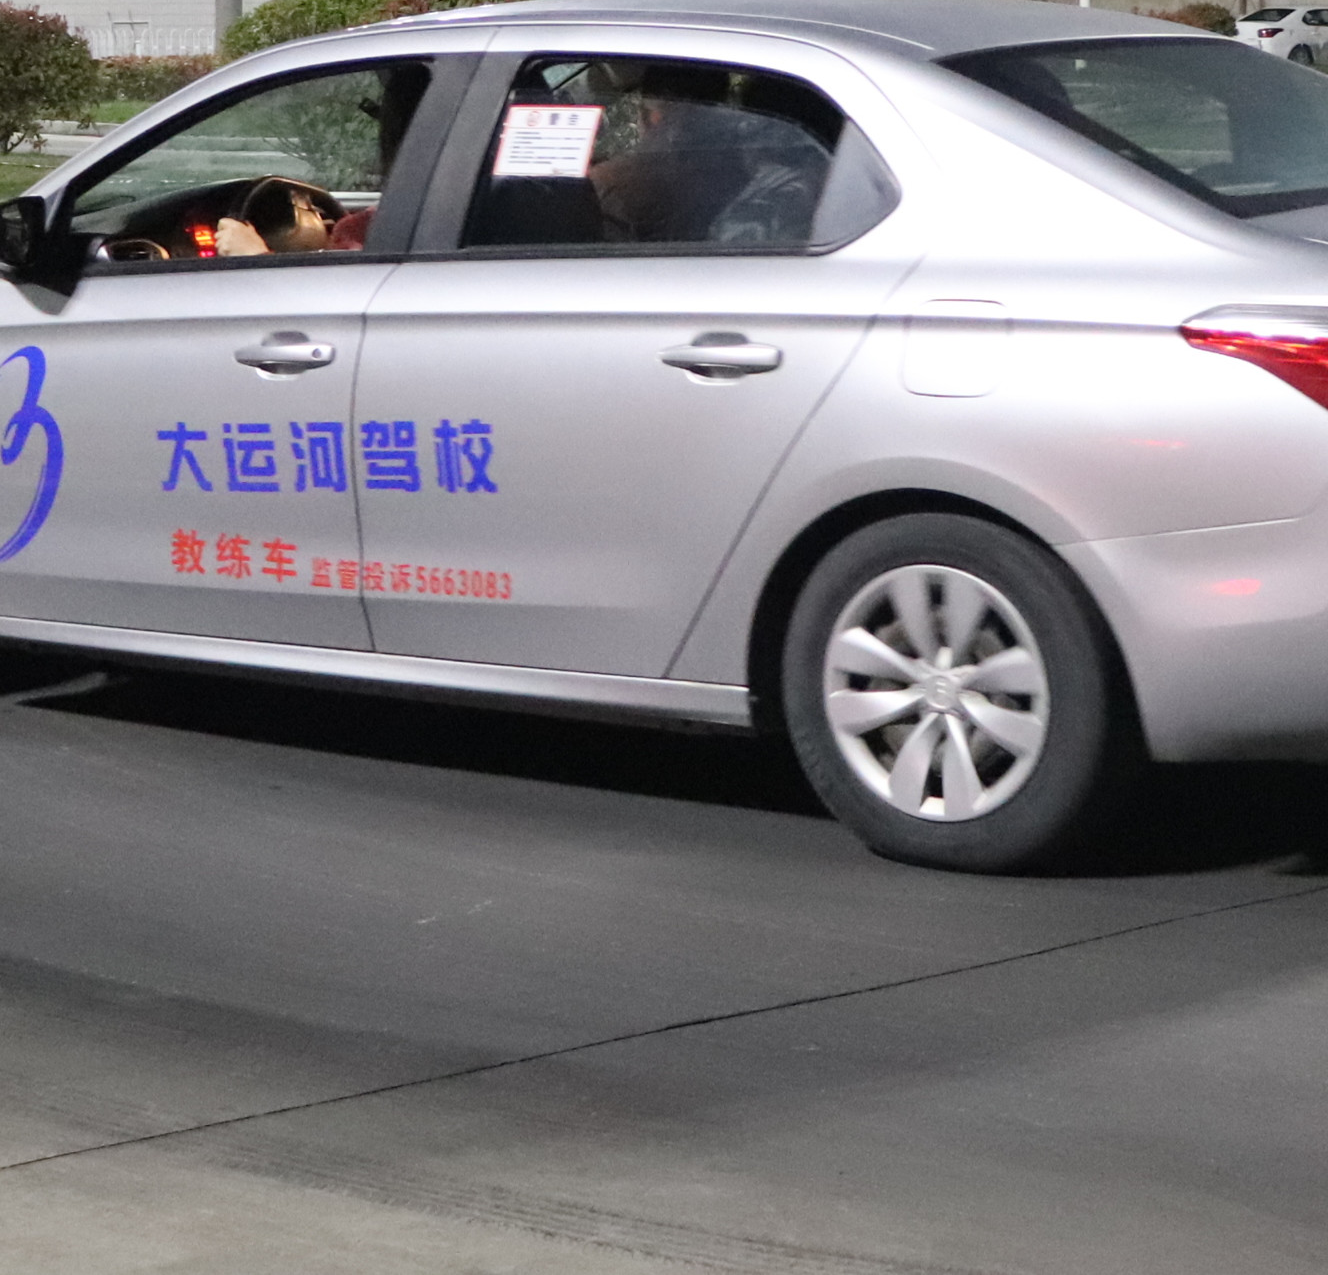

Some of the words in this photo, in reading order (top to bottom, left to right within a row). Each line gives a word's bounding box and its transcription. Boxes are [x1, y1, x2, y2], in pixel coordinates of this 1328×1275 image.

[156, 419, 498, 493] 大运河驾校
[171, 528, 298, 582] 教练车
